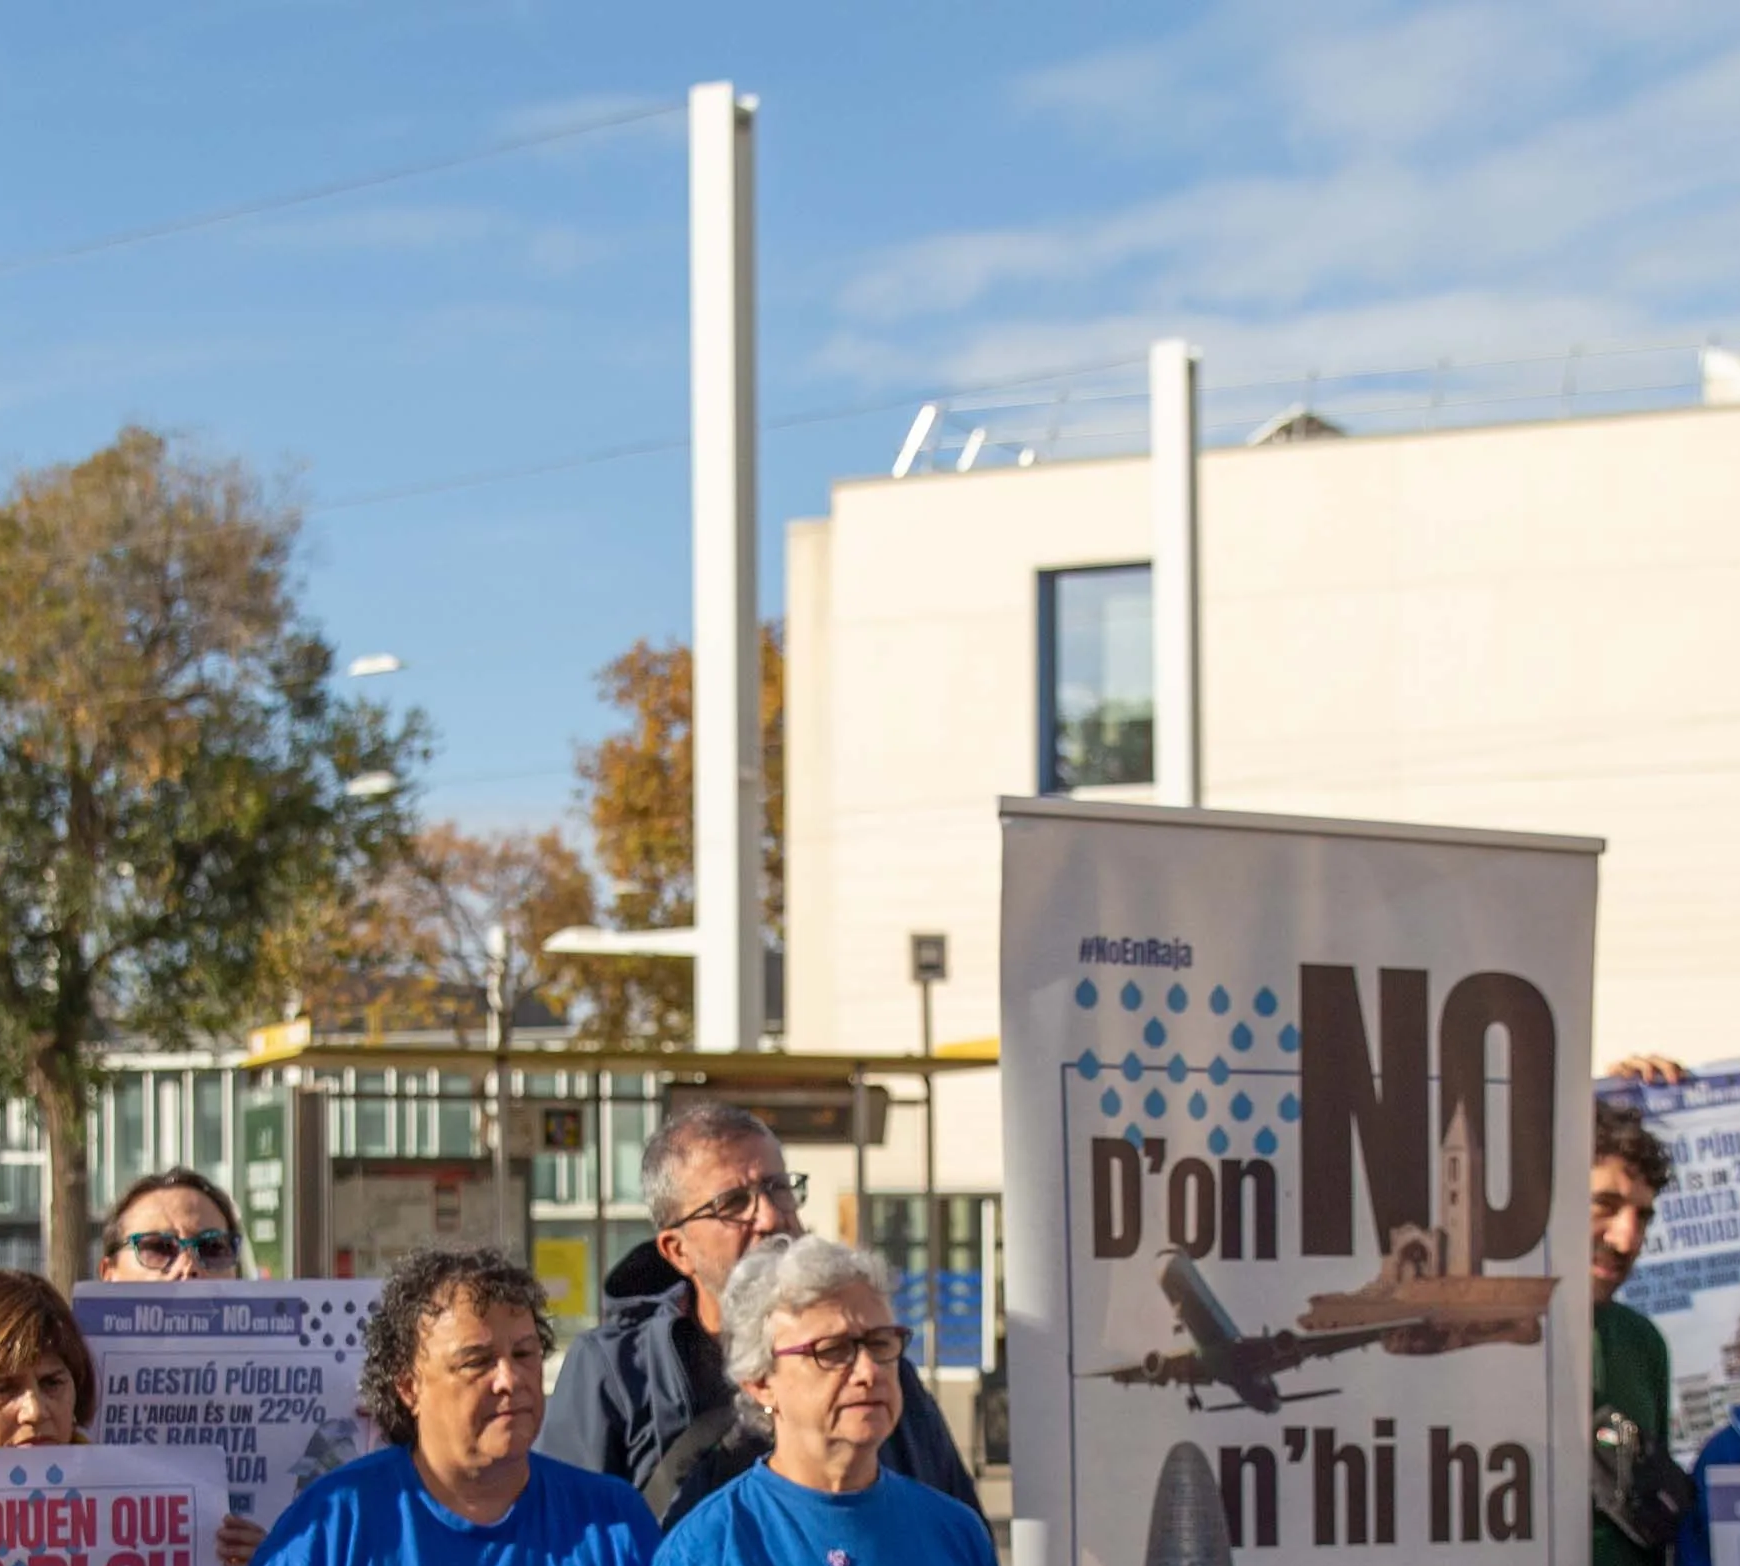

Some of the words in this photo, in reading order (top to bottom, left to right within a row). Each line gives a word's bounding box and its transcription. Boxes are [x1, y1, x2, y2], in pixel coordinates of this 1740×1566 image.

[1079, 938, 1193, 971] #NoEnRaja
[1091, 1138, 1278, 1261] D'on
[1300, 964, 1555, 1259] NO
[109, 1375, 128, 1394] LA
[135, 1362, 216, 1395] GESTIÓ
[226, 1362, 323, 1395] PÚBLICA
[1429, 1428, 1533, 1544] ha
[111, 1495, 190, 1548] QUE
